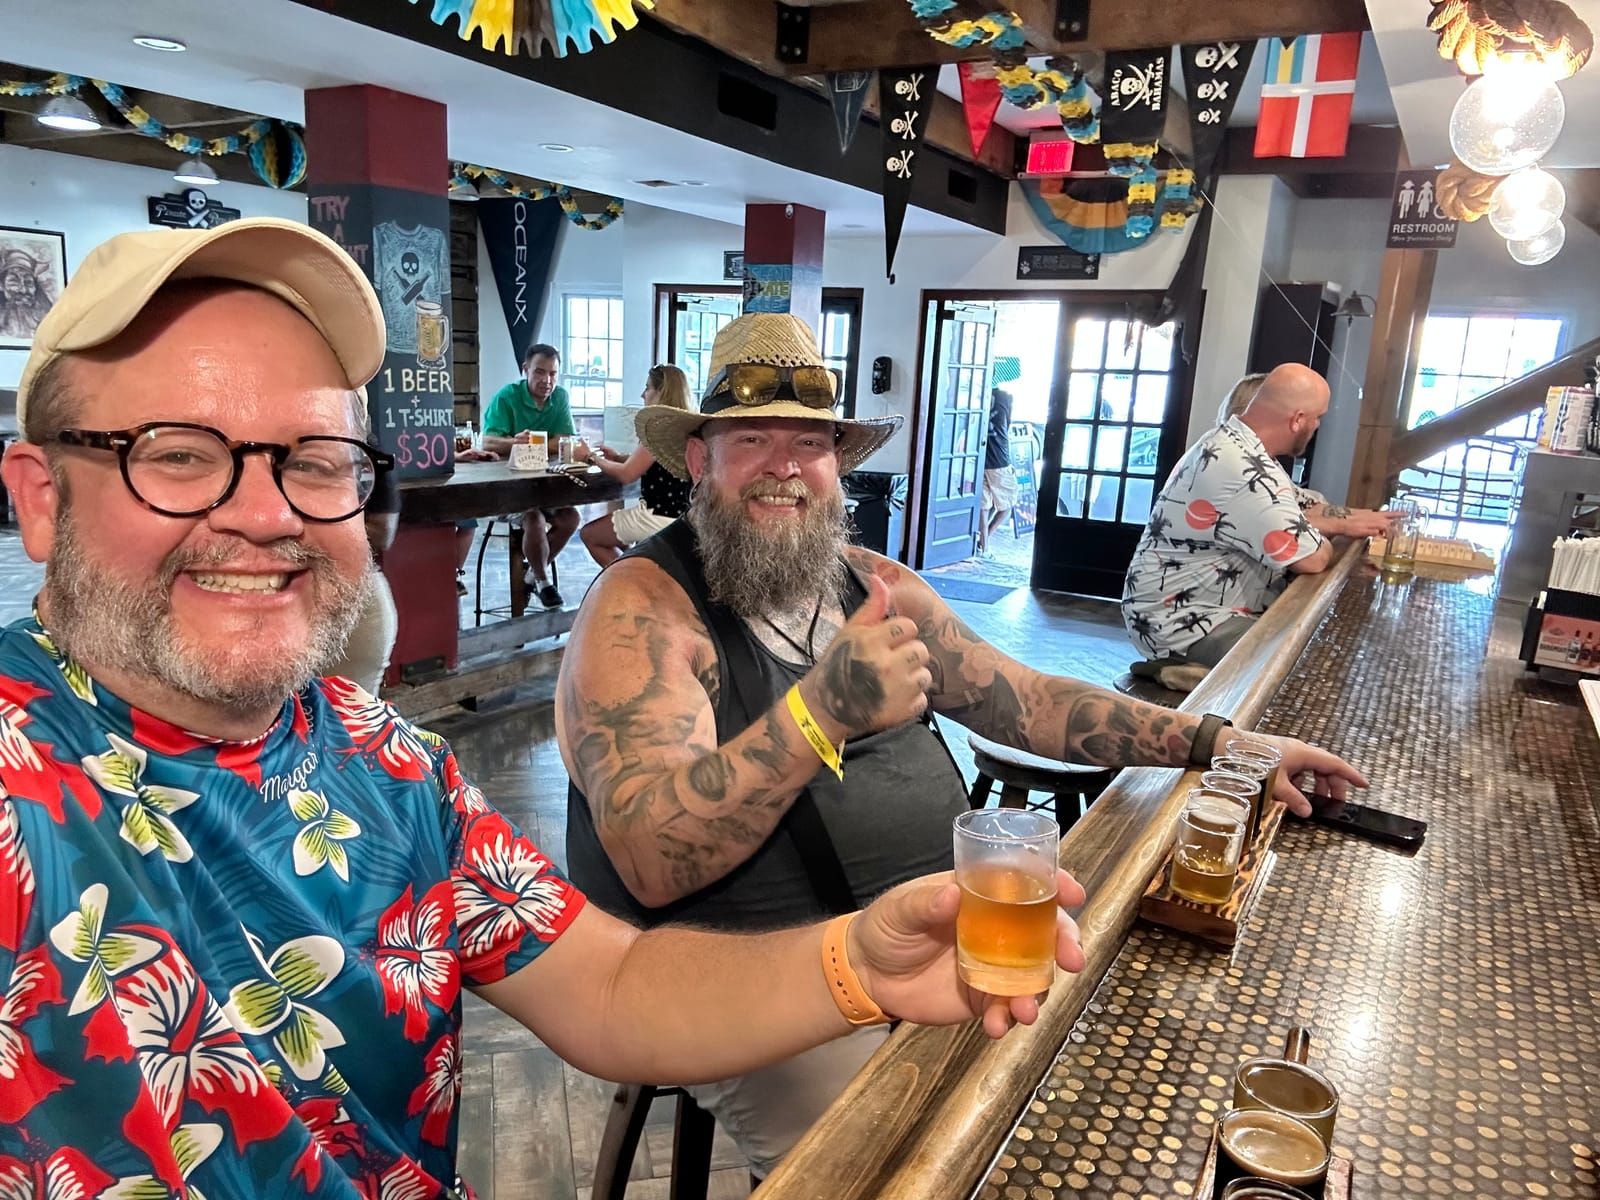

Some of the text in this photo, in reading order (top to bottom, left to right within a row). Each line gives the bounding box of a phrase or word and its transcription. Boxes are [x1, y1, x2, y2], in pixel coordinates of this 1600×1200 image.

[1110, 69, 1123, 106] ABACO
[1151, 56, 1165, 111] BAHAMAS
[311, 195, 350, 222] TRY
[334, 223, 345, 243] A
[1392, 223, 1455, 234] RESTROOM
[513, 202, 528, 327] OCEANX
[384, 367, 452, 394] 1 BEER
[385, 407, 453, 428] 1 T-SHIRT
[397, 430, 448, 469] $30
[259, 751, 319, 803] Margar
